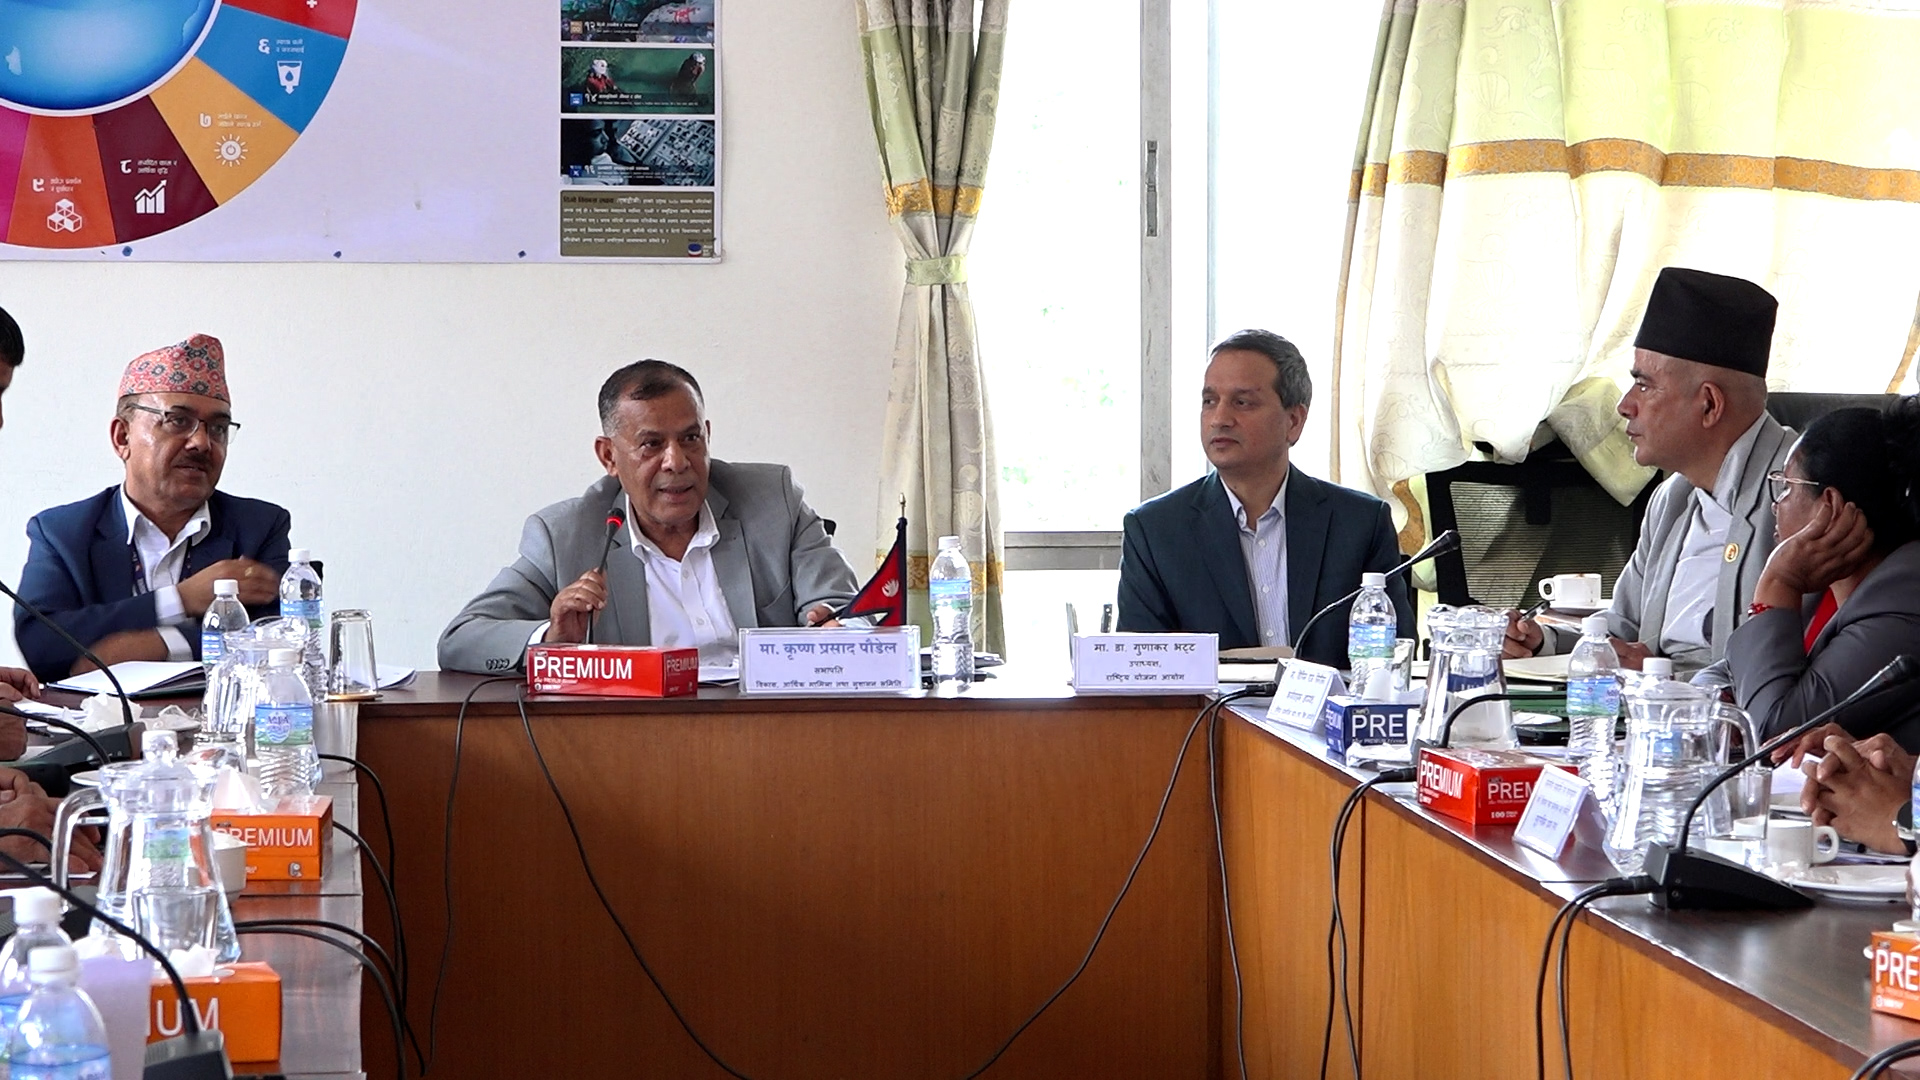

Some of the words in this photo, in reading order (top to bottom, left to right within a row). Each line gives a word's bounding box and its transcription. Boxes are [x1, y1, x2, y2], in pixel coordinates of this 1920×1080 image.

[258, 38, 270, 55] ६
[199, 112, 212, 128] ७
[120, 159, 132, 174] ८
[759, 643, 780, 656] मा.
[783, 643, 816, 661] कृष्ण
[819, 642, 856, 656] प्रसाद
[858, 637, 897, 655] पौडेल
[1094, 643, 1109, 653] मा.
[1133, 643, 1169, 656] गुणाकर
[533, 656, 632, 679] PREMIUM
[814, 665, 844, 674] सभापति
[1420, 760, 1464, 799] PREMIUM
[1487, 782, 1534, 800] PREM
[215, 828, 313, 846] REMIUM
[1875, 949, 1920, 992] PRE
